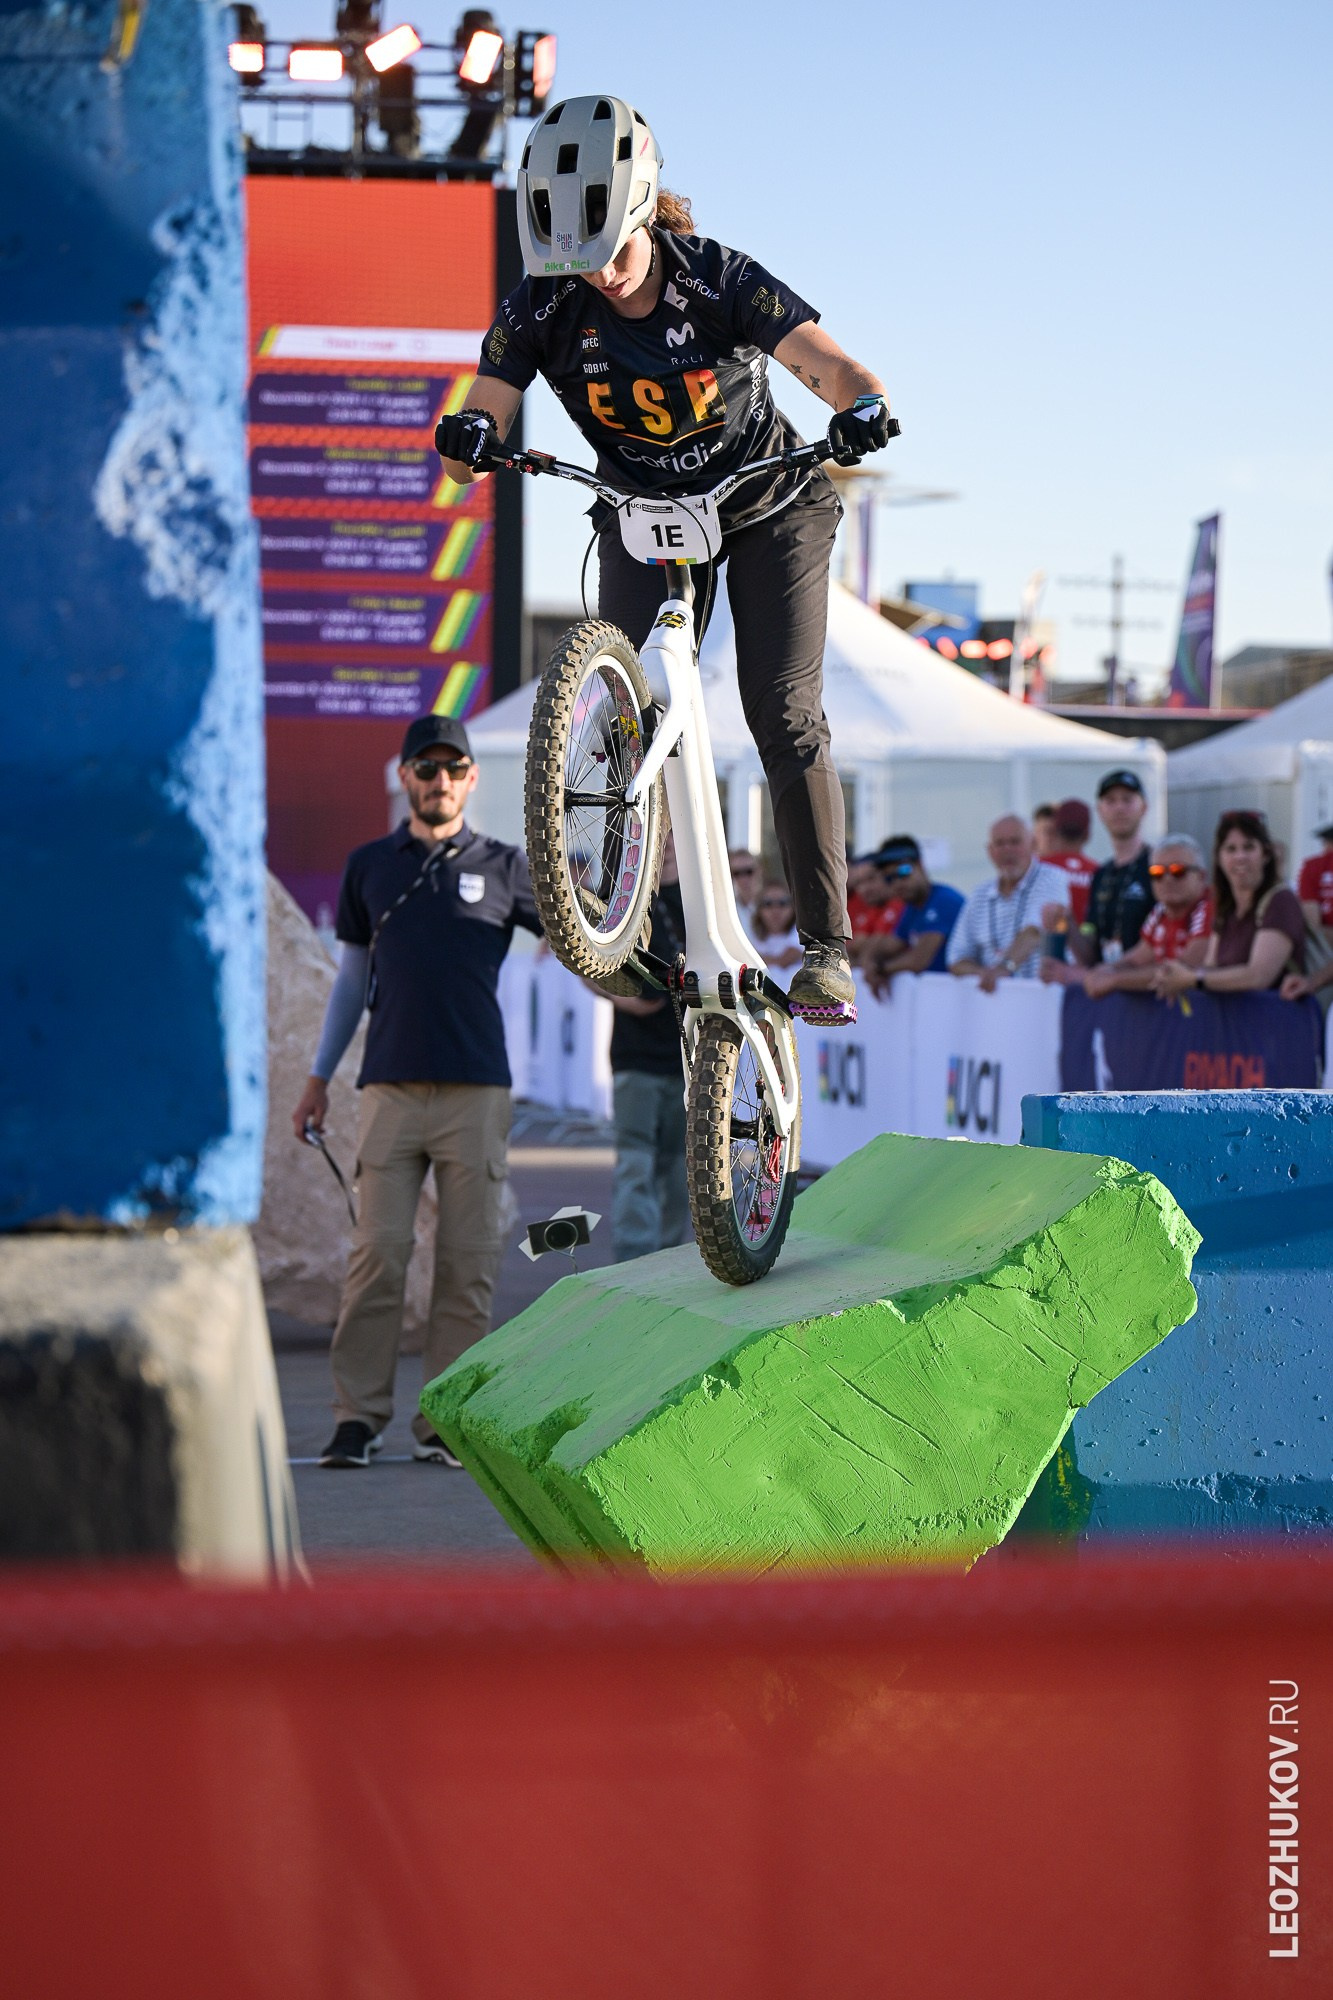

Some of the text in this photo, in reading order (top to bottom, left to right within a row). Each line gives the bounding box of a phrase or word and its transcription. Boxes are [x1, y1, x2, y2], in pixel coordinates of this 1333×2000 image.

[582, 361, 610, 374] GOBIK
[671, 354, 703, 365] RALI
[587, 369, 723, 436] ESP
[711, 475, 738, 499] LEAN
[630, 502, 642, 510] UCI
[650, 524, 685, 548] 1E
[957, 1055, 1001, 1134] UCI
